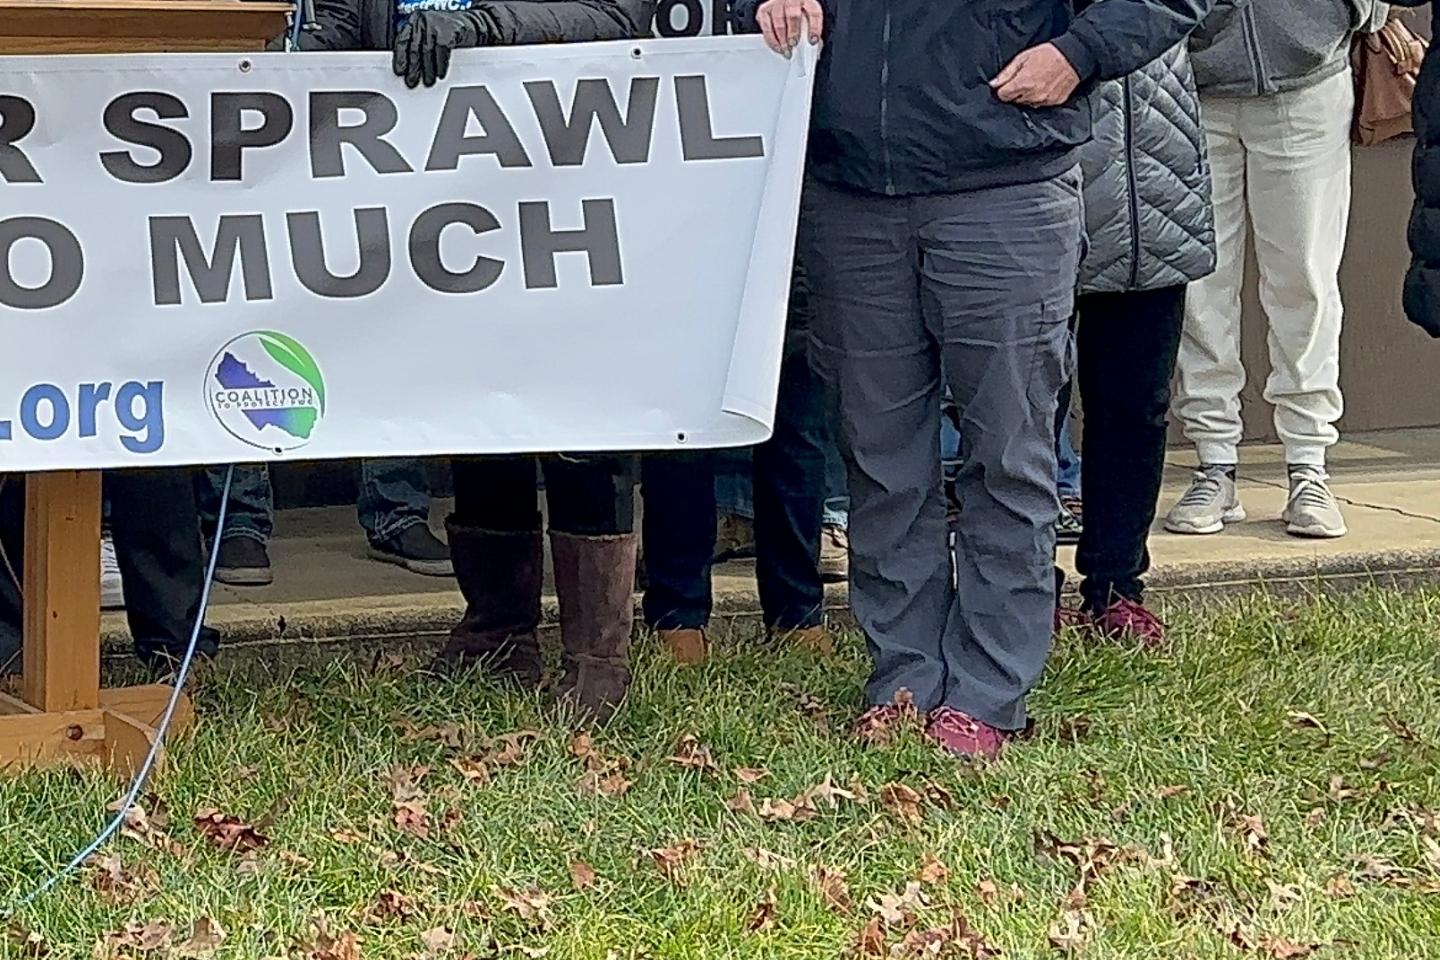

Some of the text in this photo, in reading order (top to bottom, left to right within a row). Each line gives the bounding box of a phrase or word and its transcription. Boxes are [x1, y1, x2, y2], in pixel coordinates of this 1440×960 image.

[98, 73, 766, 184] SPRAWL
[148, 197, 625, 307] MUCH
[215, 387, 313, 403] COALITION
